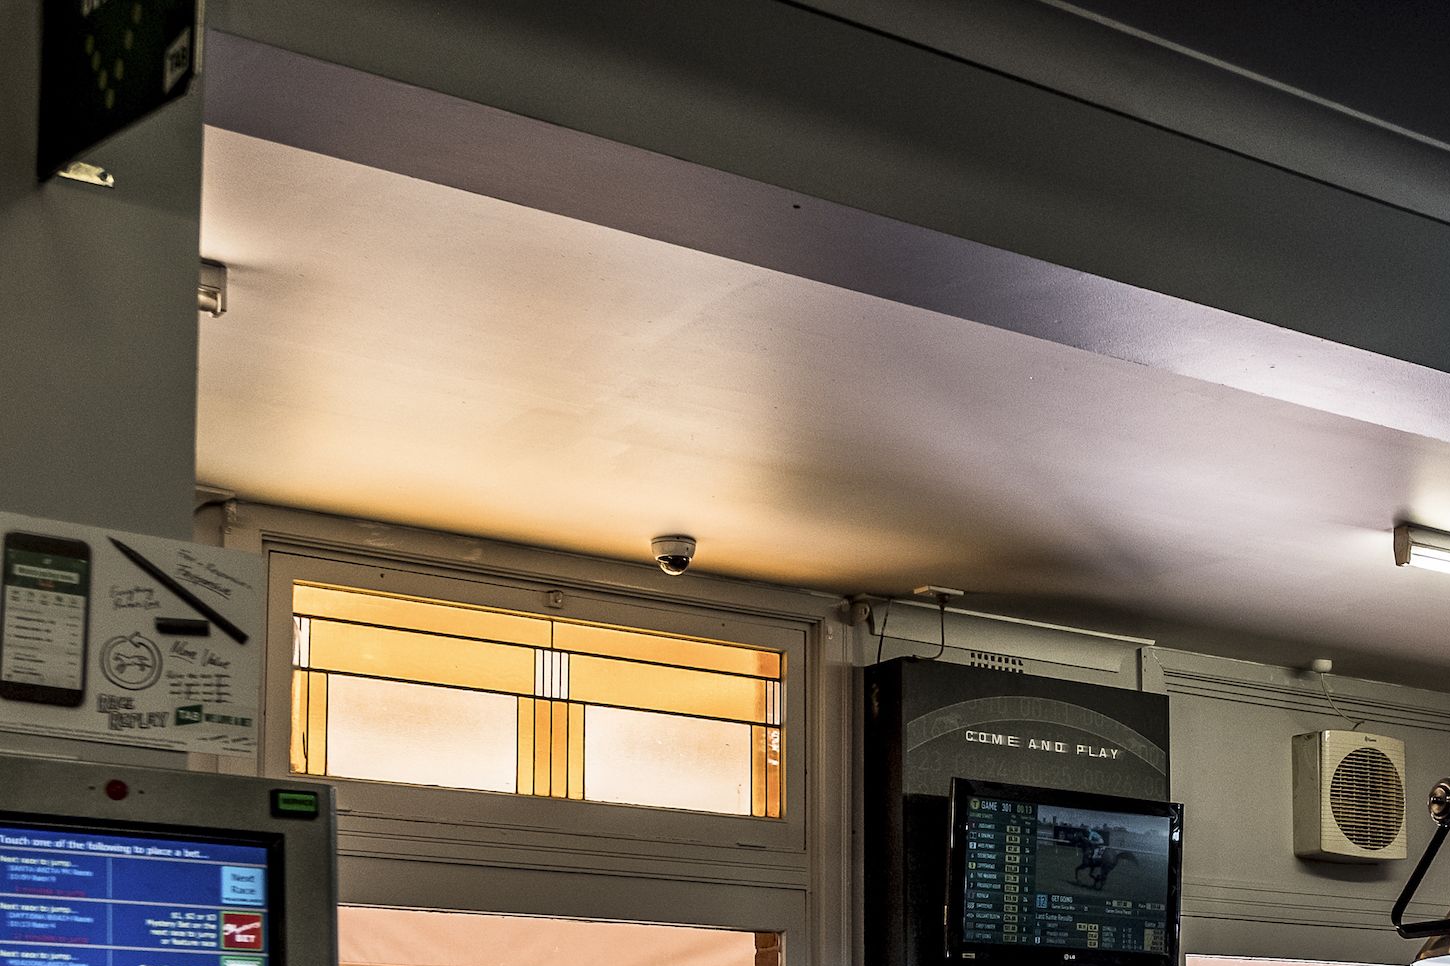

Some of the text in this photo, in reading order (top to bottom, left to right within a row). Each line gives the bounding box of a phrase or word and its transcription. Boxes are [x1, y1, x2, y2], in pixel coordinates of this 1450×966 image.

[170, 46, 187, 71] TAB
[966, 730, 1119, 760] COME AND PLAY
[981, 801, 1012, 813] GAME 301
[0, 834, 30, 845] Touch
[33, 839, 53, 848] one
[69, 840, 85, 849] the
[87, 842, 132, 854] following
[146, 847, 173, 857] place
[231, 885, 255, 895] Race
[145, 919, 175, 930] Mystery
[235, 934, 255, 943] BET
